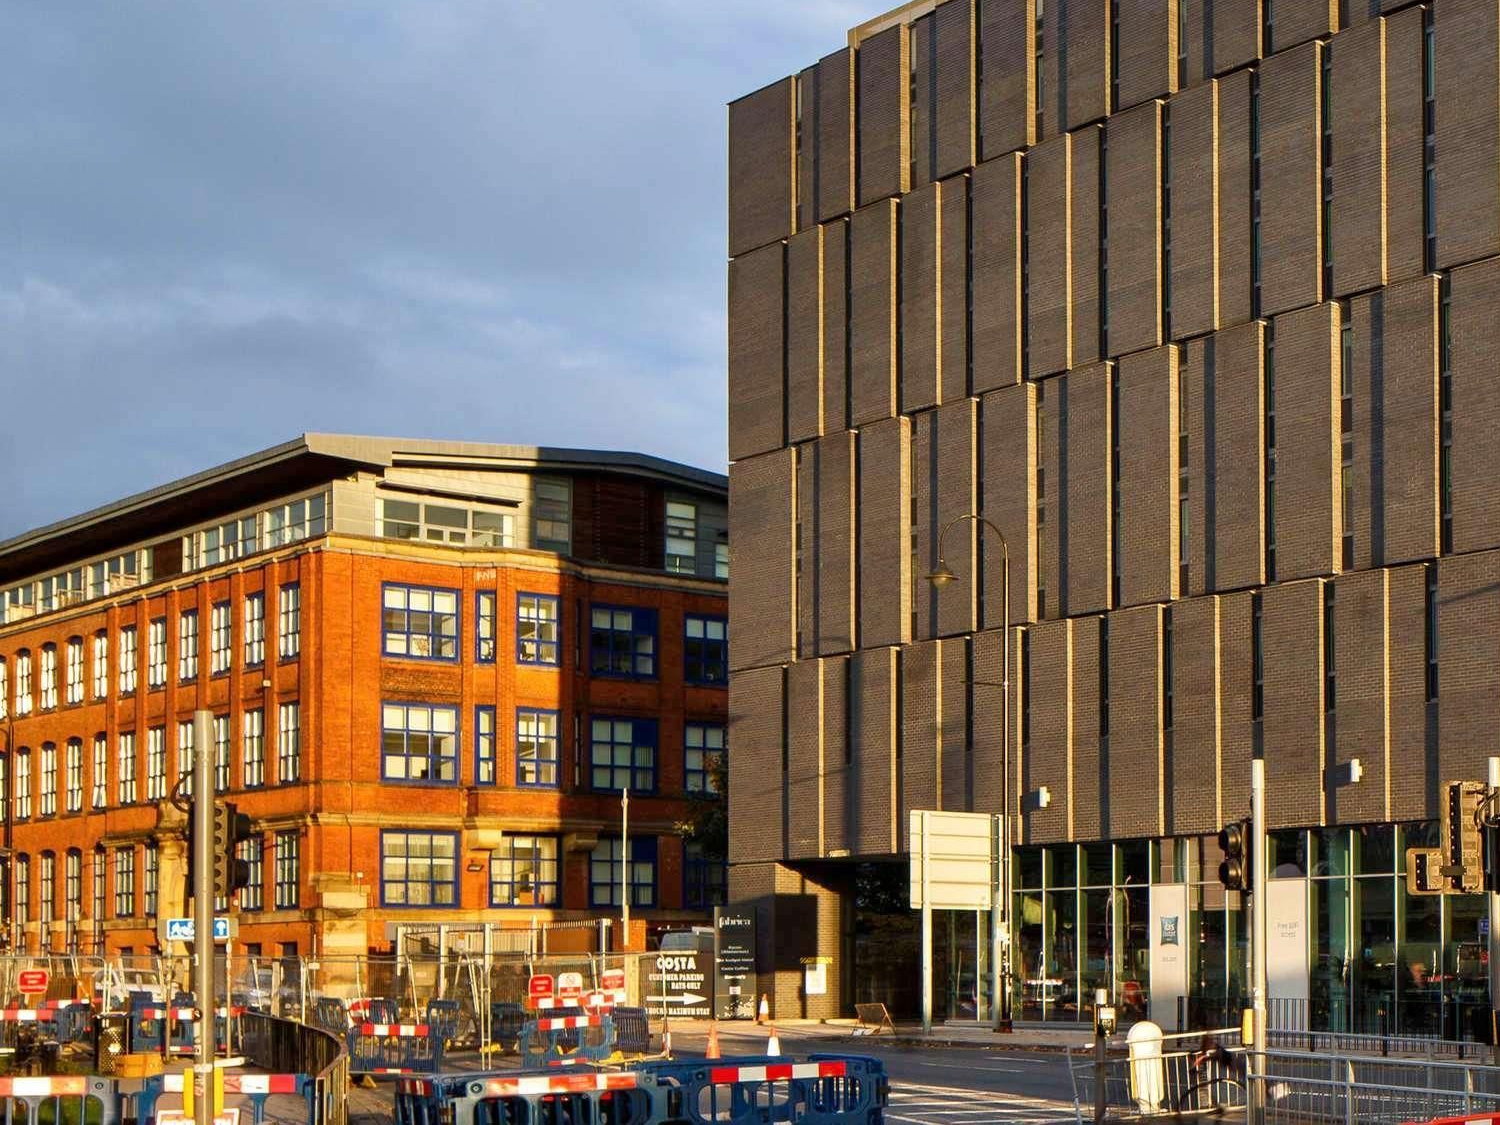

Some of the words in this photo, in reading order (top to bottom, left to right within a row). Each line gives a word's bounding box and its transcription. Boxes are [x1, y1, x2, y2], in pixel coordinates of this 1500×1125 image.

[656, 957, 697, 971] COSTA
[649, 973, 678, 981] CUSTMER
[679, 973, 705, 981] PARKING
[669, 1007, 695, 1015] MAXIMUM
[696, 1007, 710, 1015] STAY
